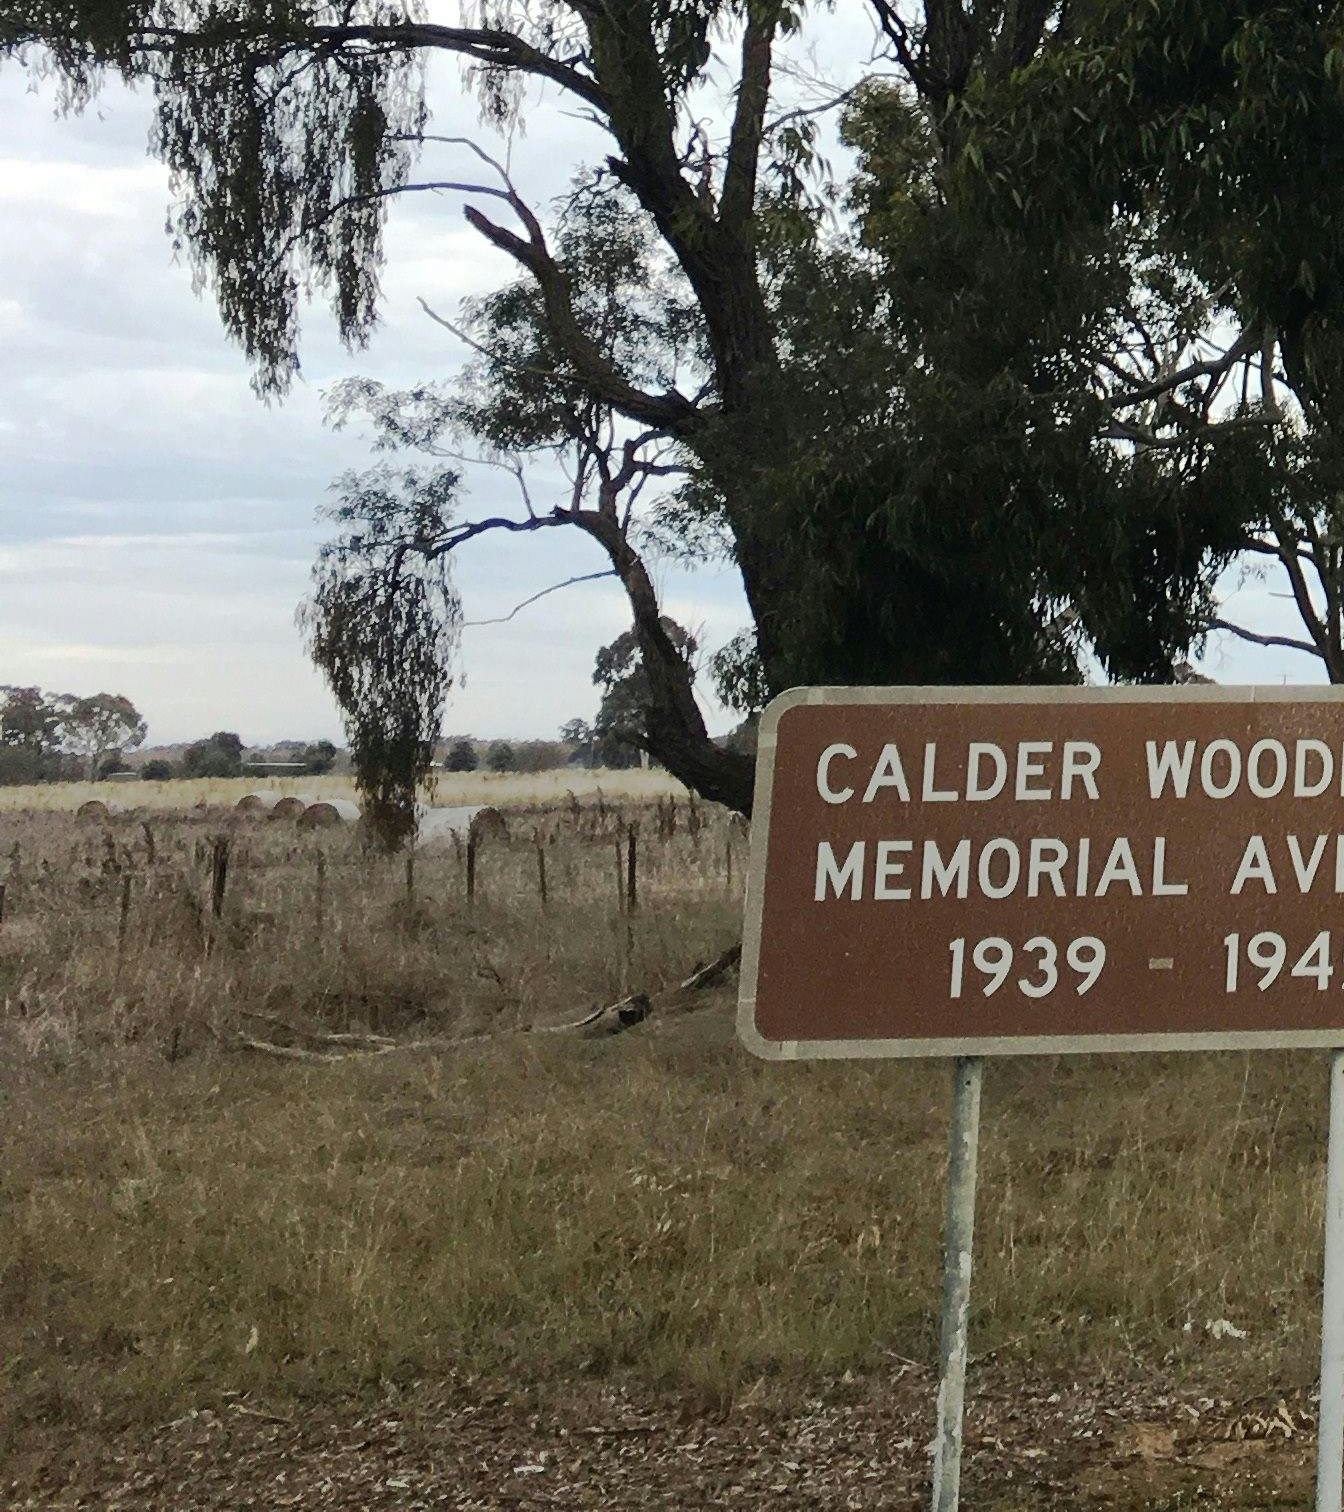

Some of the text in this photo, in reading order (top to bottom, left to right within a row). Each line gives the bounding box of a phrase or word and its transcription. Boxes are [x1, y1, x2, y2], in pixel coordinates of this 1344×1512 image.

[816, 740, 1103, 804] CALDER
[813, 835, 1190, 902] MEMORIAL
[948, 935, 1107, 999] 1939
